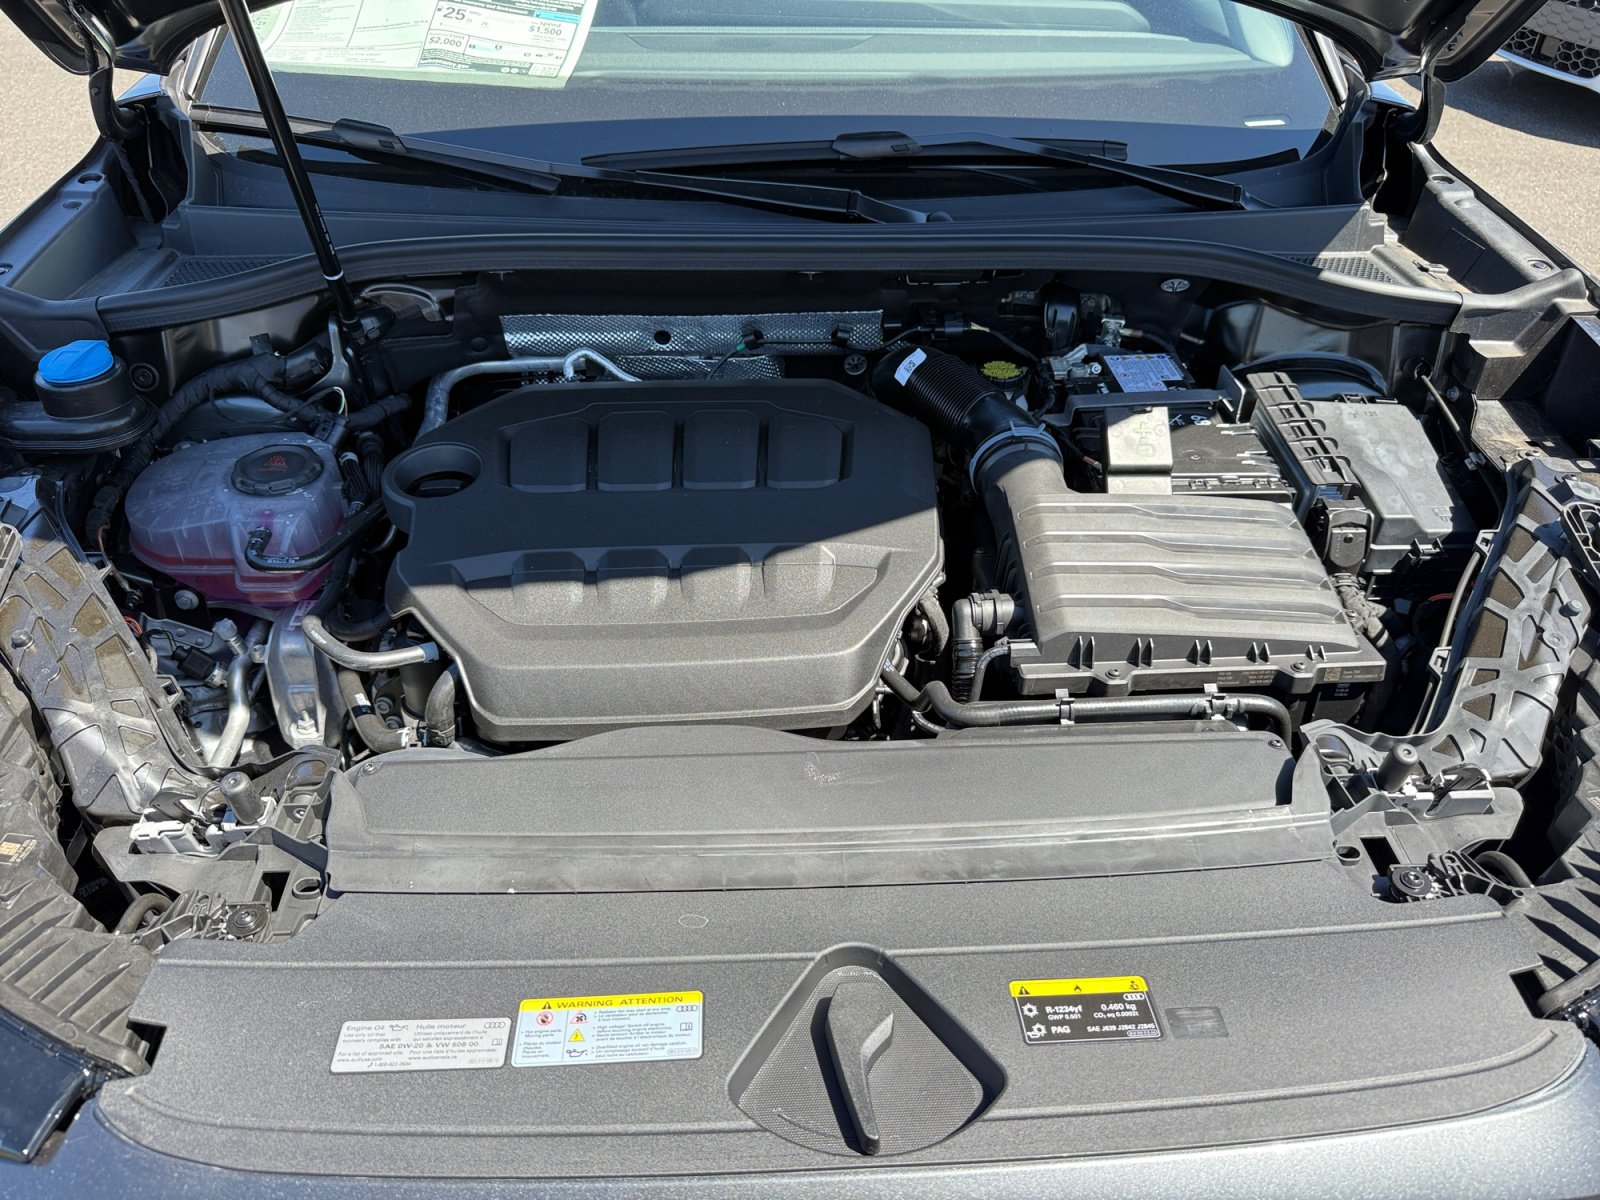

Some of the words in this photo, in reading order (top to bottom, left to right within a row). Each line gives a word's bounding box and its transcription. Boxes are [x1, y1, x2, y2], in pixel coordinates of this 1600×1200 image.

[443, 6, 467, 22] 25
[529, 25, 562, 36] $1,500
[428, 36, 462, 47] $2,000
[557, 999, 613, 1009] WARNING
[620, 996, 684, 1006] ATTENTION
[1045, 1004, 1082, 1014] R-1234yf
[1125, 1002, 1137, 1012] kg
[1051, 1025, 1071, 1034] PAG
